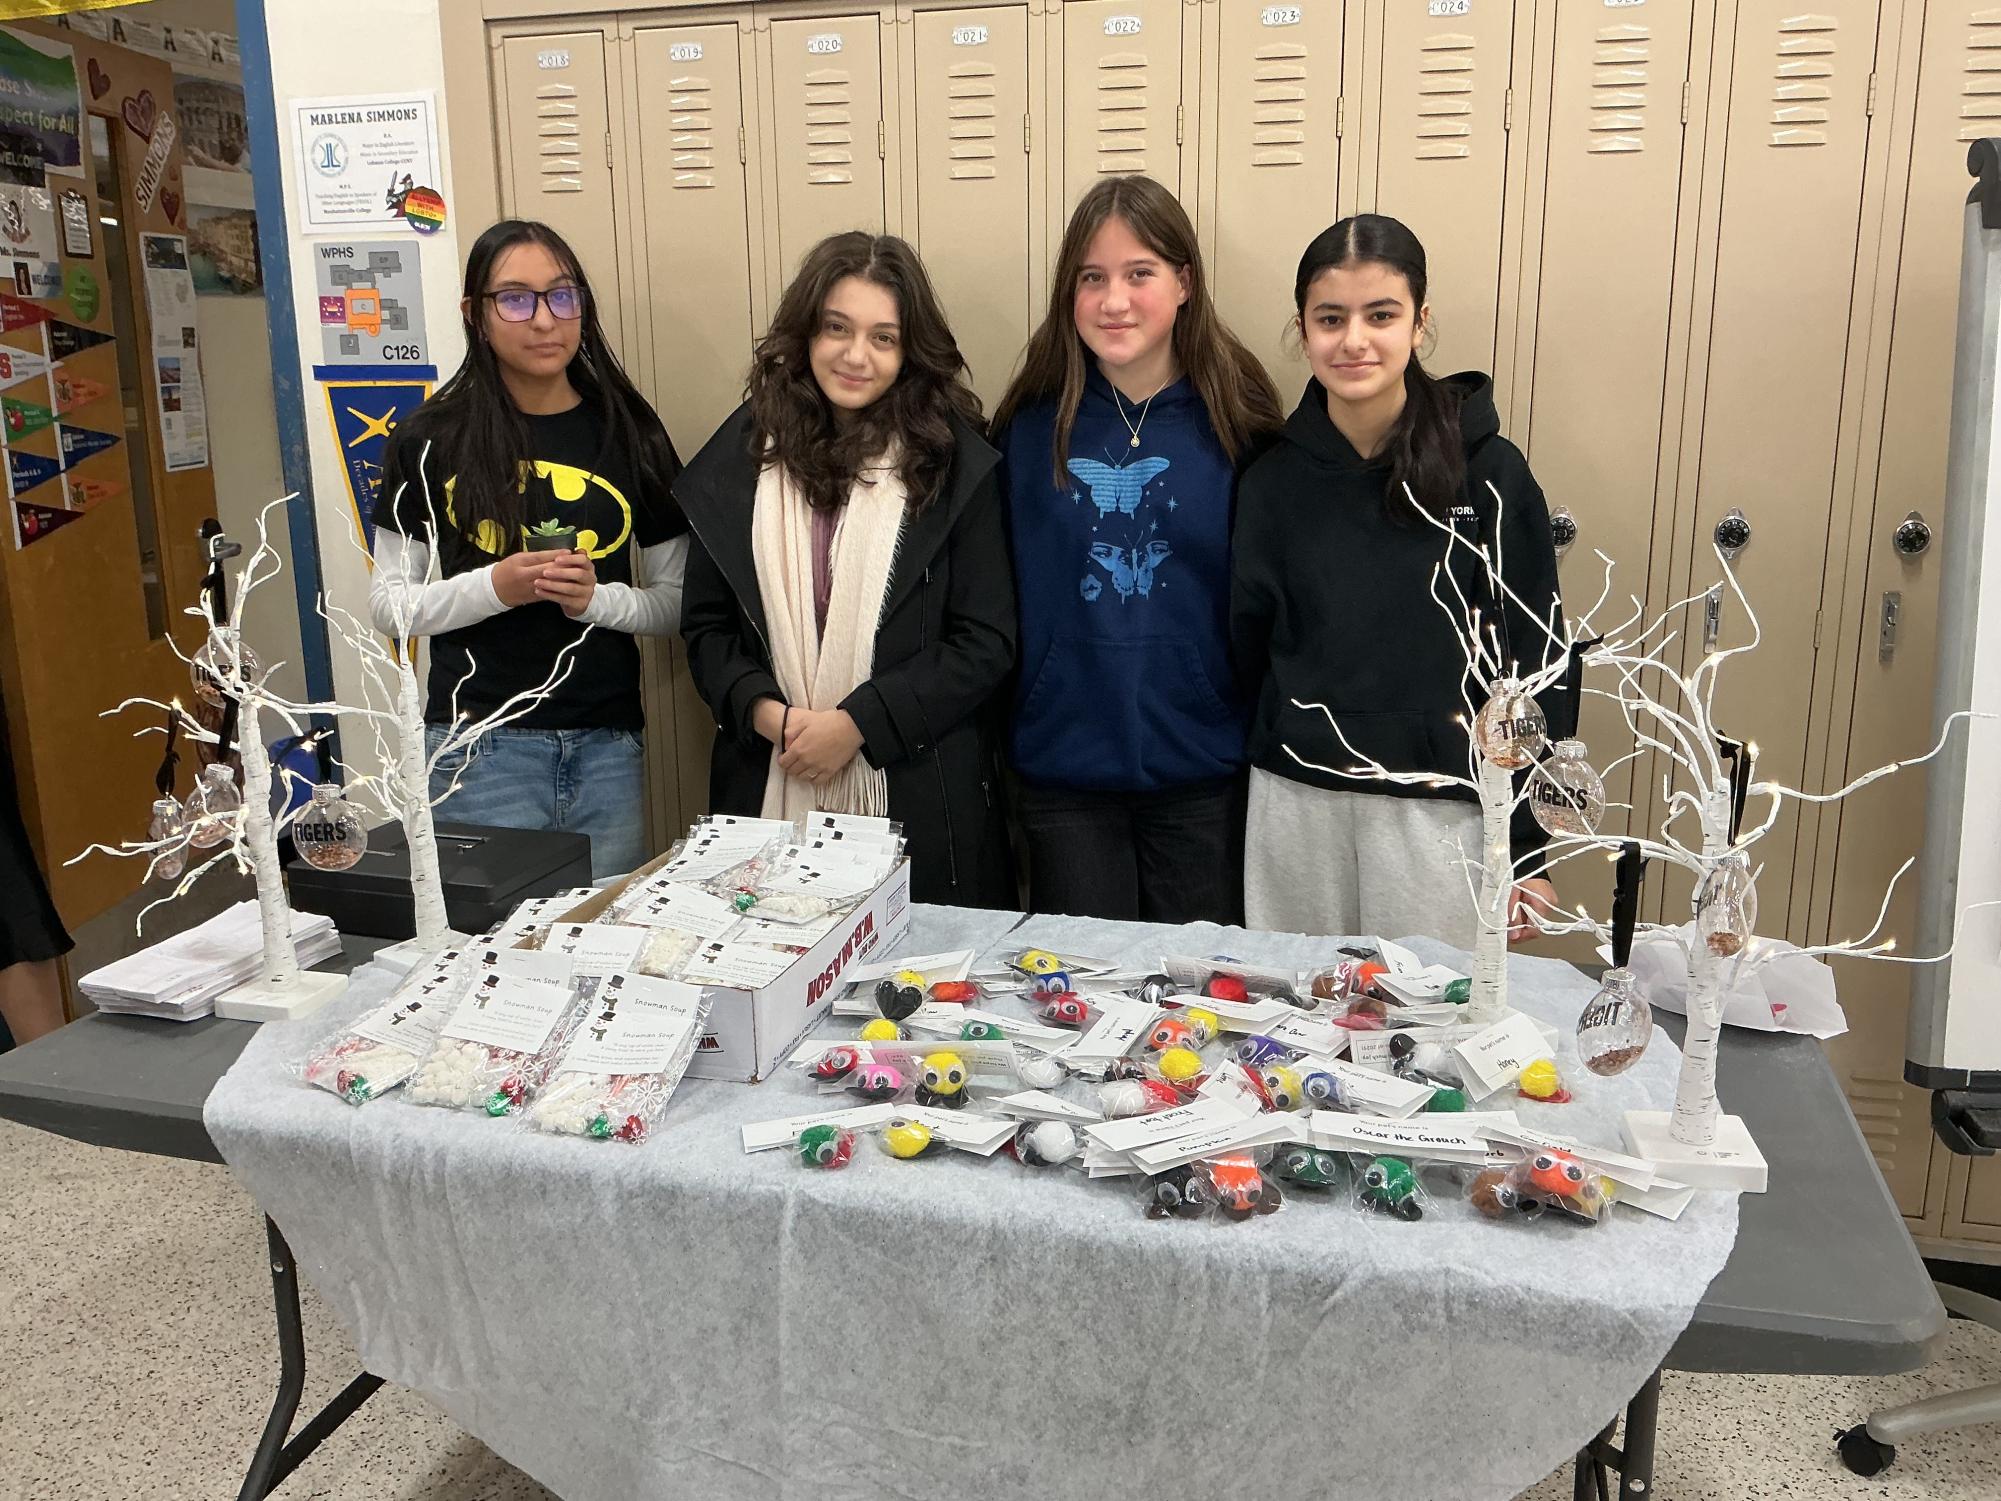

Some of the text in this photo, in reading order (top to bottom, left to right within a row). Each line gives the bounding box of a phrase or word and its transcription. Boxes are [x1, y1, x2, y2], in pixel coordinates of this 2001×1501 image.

[38, 109, 57, 130] for
[59, 115, 74, 135] All
[310, 108, 418, 126] MARLENA SIMMONS
[136, 114, 175, 209] SIMMONS
[321, 246, 354, 259] WPHS
[382, 345, 421, 361] C126
[352, 459, 369, 503] Decades
[1532, 779, 1588, 811] TIGERS
[544, 977, 560, 987] Soup
[504, 1000, 553, 1016] Snowman Soup
[635, 998, 687, 1014] Snowman Soup
[1178, 1136, 1232, 1152] Pumpkin
[1352, 1126, 1466, 1146] Oscar the Grouch
